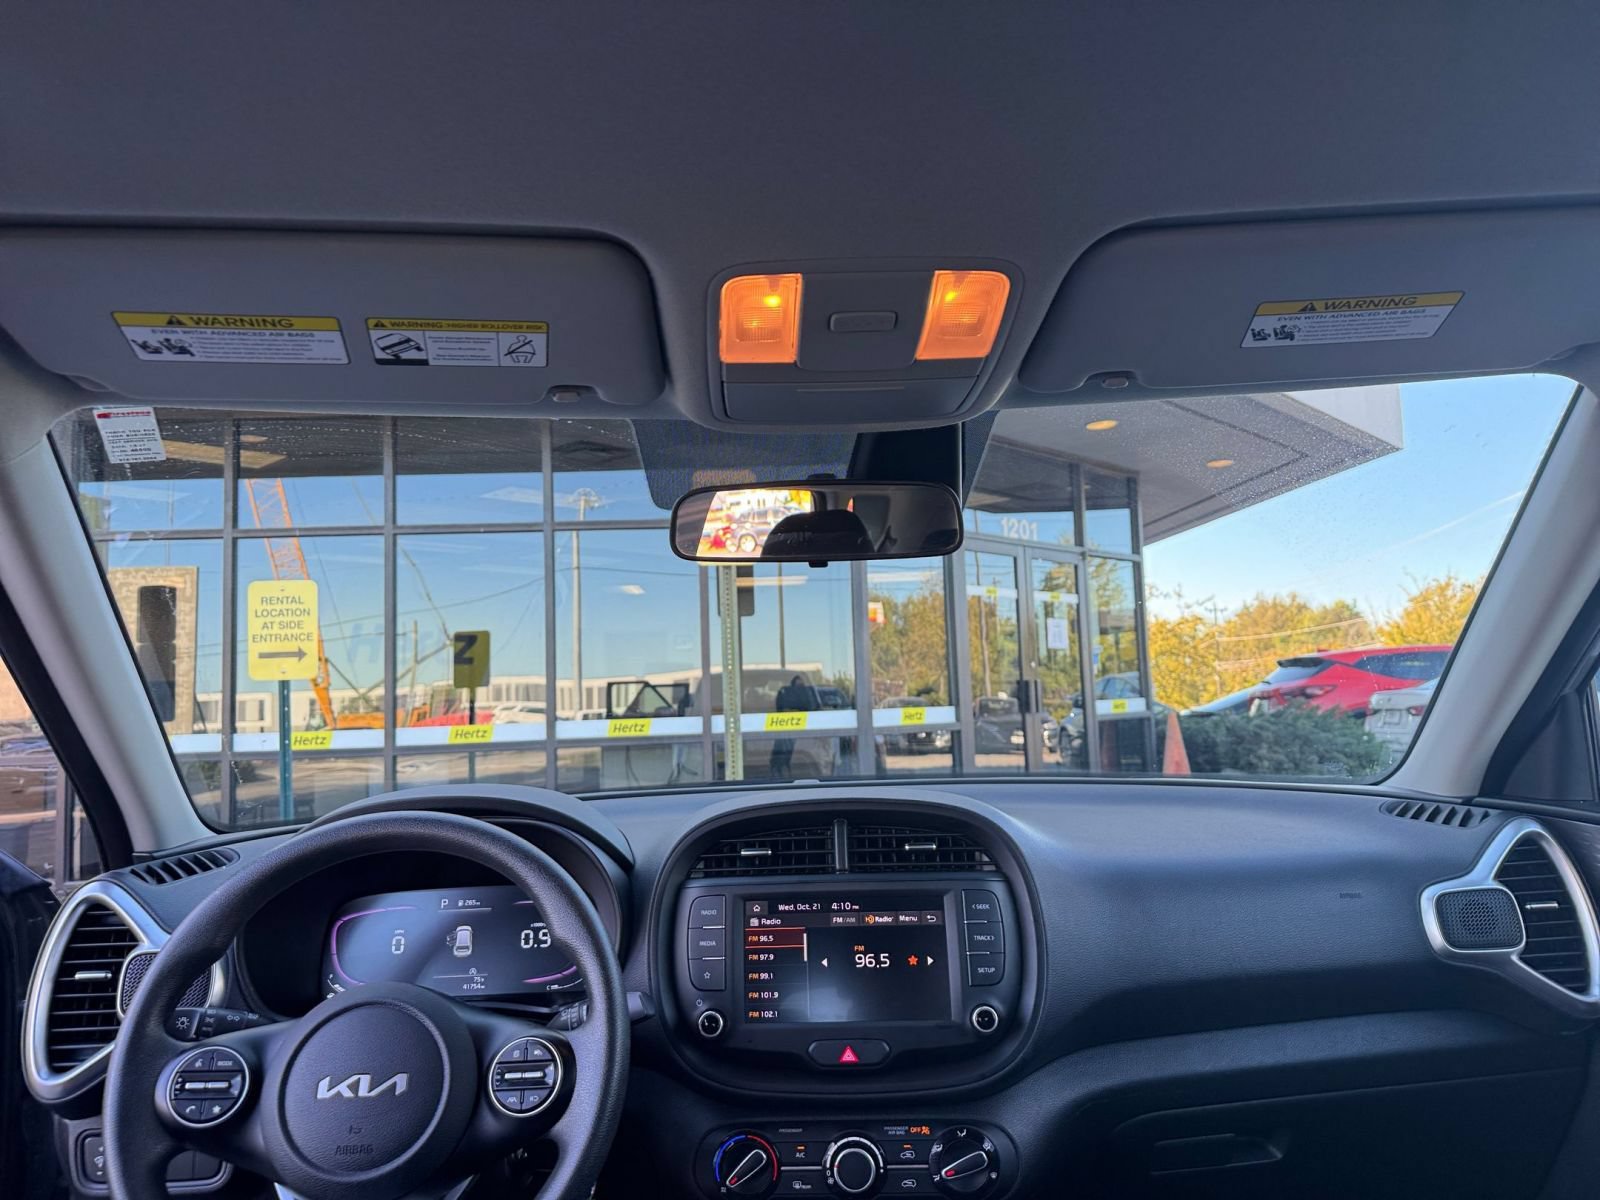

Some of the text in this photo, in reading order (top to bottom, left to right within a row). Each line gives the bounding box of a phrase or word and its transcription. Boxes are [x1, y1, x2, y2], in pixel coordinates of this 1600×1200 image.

[1323, 296, 1418, 311] WARNING
[189, 315, 295, 329] WARNING
[1001, 516, 1038, 541] 1201
[260, 595, 305, 606] RENTAL
[254, 607, 311, 618] LOCATION
[261, 620, 304, 630] AT SIDE
[252, 632, 314, 643] ENTRANCE
[770, 715, 802, 727] Hertz
[613, 722, 646, 733] Hertz
[454, 728, 488, 739] Hertz
[293, 734, 328, 746] Hertz
[441, 899, 449, 909] P
[831, 902, 851, 910] 4:10
[521, 929, 552, 948] 0.9
[391, 936, 405, 954] 0
[855, 953, 890, 968] 96.5
[760, 991, 779, 999] 101.9
[910, 1126, 922, 1134] OFF
